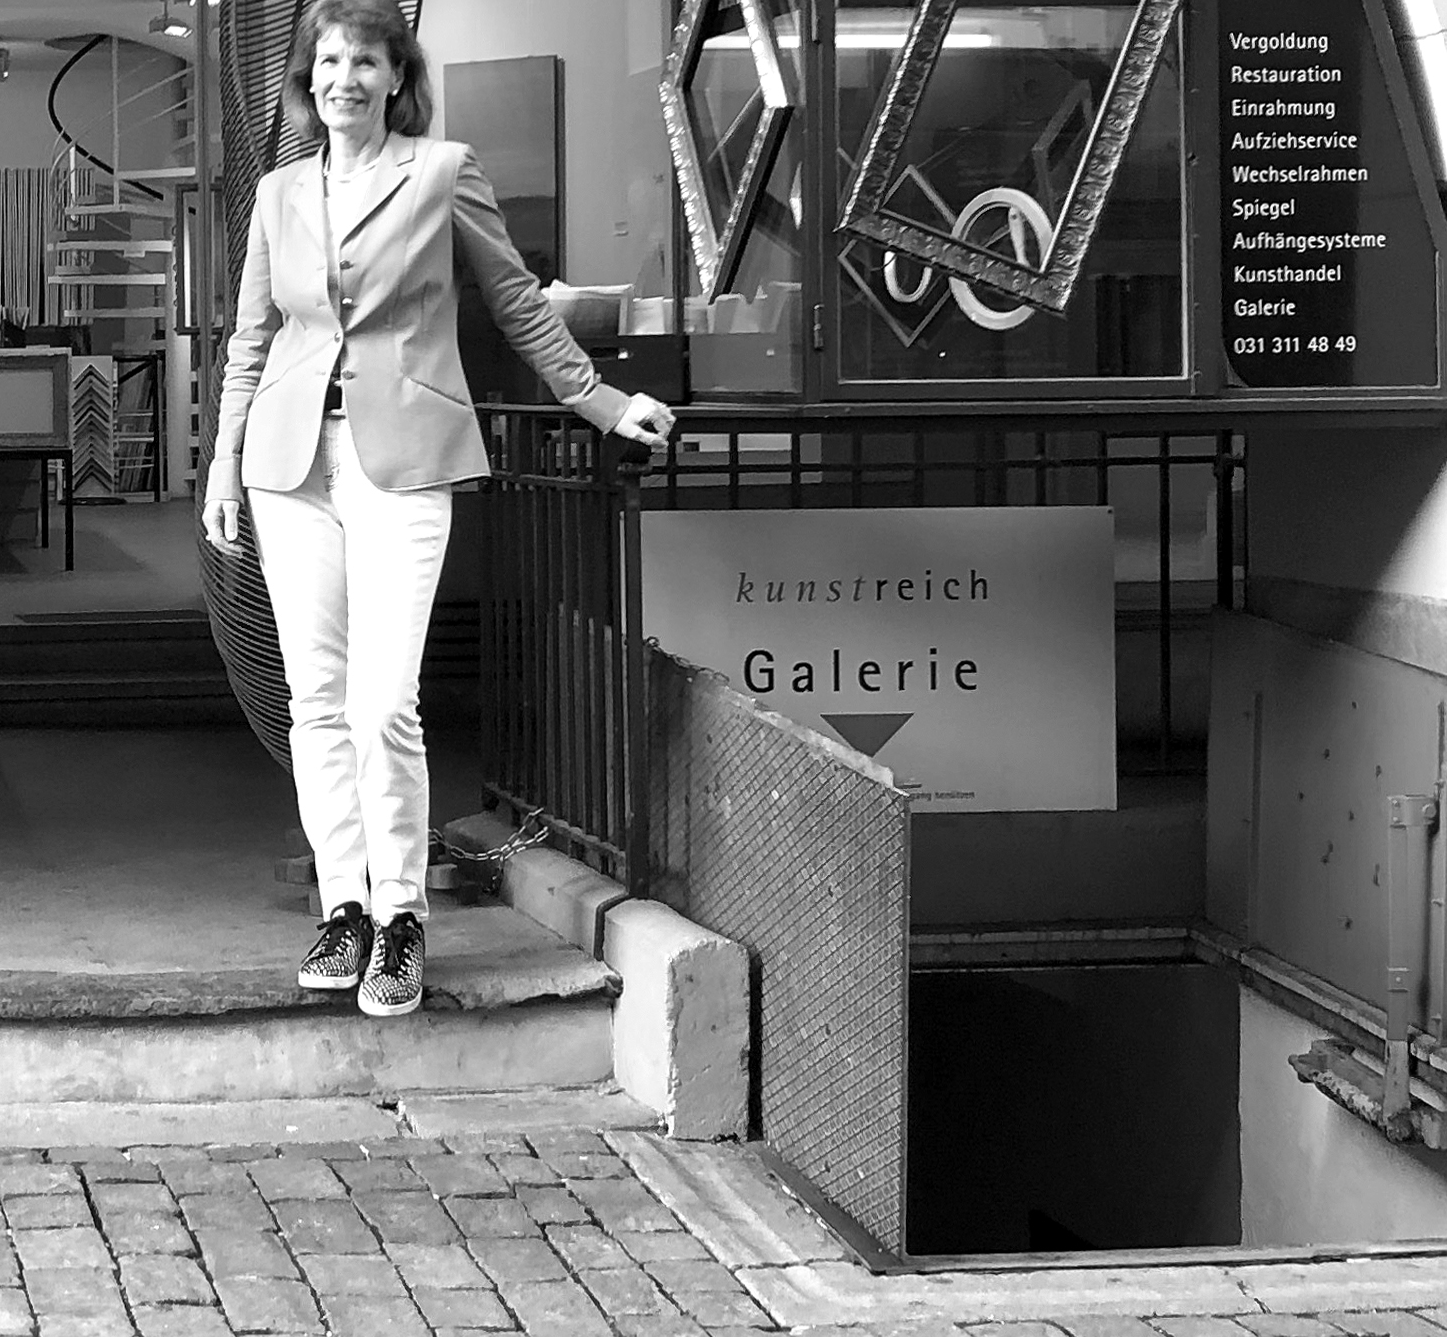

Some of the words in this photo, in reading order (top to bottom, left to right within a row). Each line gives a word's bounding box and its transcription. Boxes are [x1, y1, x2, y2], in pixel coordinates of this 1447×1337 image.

[1229, 32, 1329, 54] Vergoldung
[1230, 64, 1342, 84] Restauration
[1231, 98, 1336, 120] Einrahmung
[1231, 131, 1358, 151] Aufziehservice
[1231, 164, 1369, 184] Wechselrahmen
[1232, 198, 1296, 220] Spiegel
[1232, 231, 1387, 254] Aufhängesysteme
[1233, 264, 1342, 284] Kunsthandel
[1233, 298, 1297, 318] Galerie
[1233, 336, 1265, 355] 031
[1271, 336, 1300, 354] 311
[1306, 336, 1330, 354] 48
[1334, 334, 1357, 353] 49
[736, 569, 990, 603] kunstreich
[743, 648, 979, 694] Galerie
